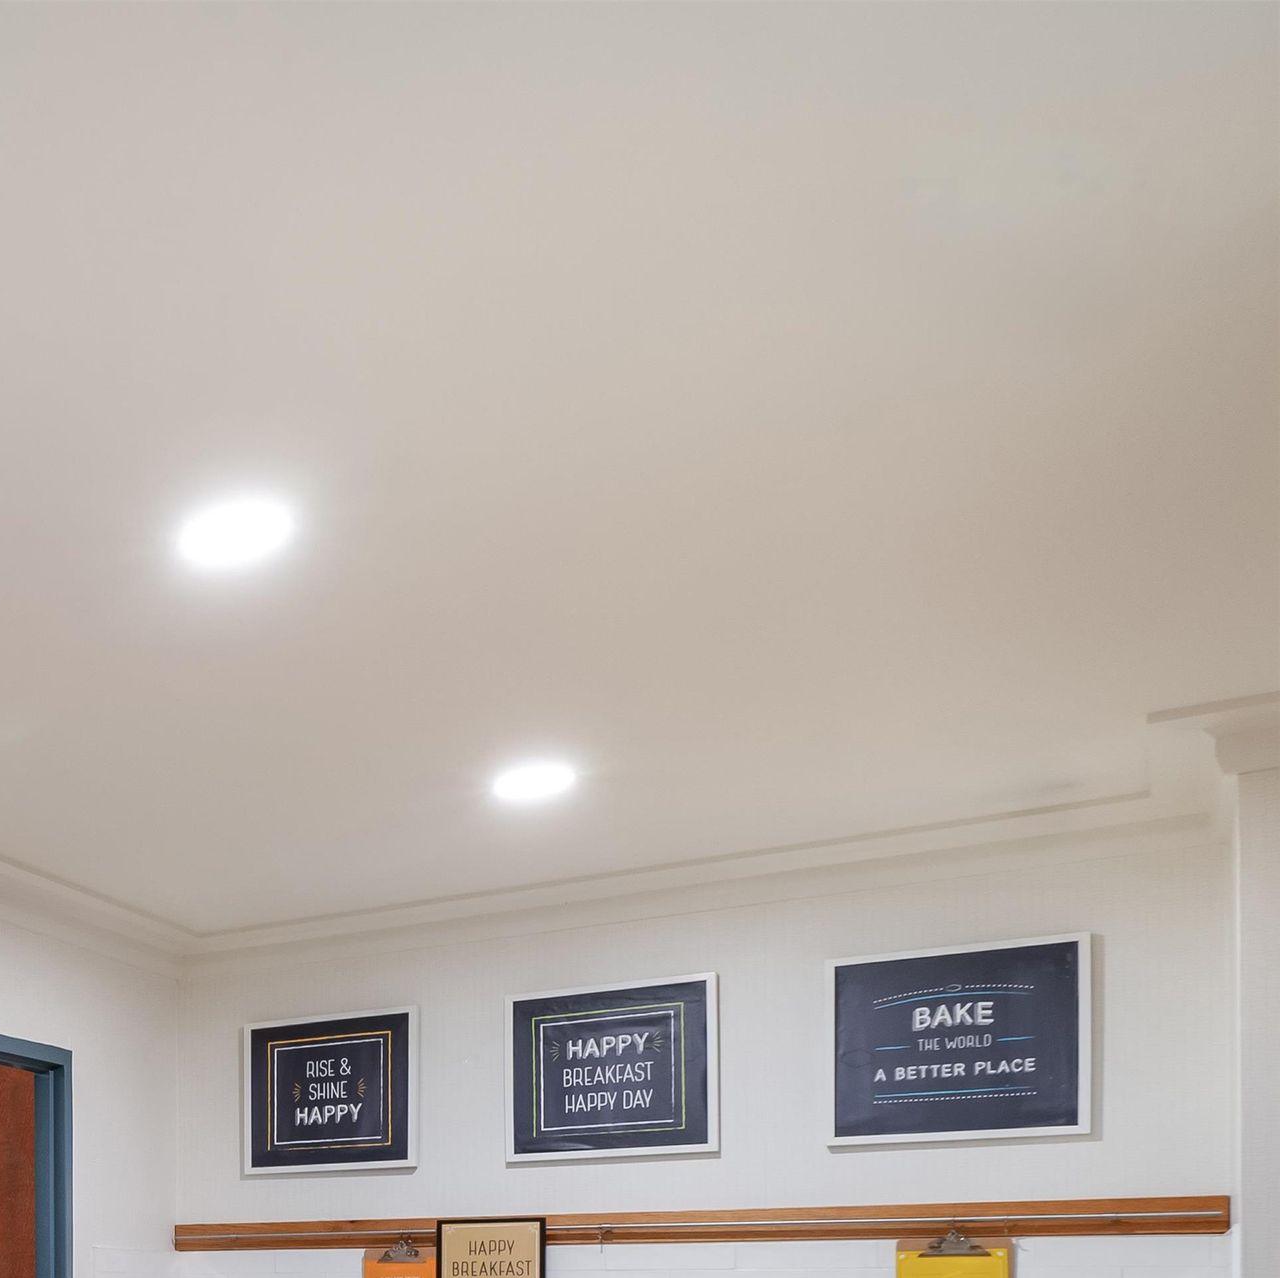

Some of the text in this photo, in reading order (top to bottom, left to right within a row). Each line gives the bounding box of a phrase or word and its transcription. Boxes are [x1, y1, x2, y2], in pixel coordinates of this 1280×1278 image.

[912, 1001, 995, 1032] BAKE
[566, 1032, 649, 1060] HAPPY
[917, 1034, 992, 1051] THE WORLD
[306, 1057, 351, 1078] RISE &
[563, 1061, 654, 1088] BREAKFAST
[873, 1057, 1037, 1082] A BETTER PLACE
[308, 1080, 348, 1101] SHINE
[565, 1088, 653, 1114] HAPPY DAY
[295, 1103, 363, 1126] HAPPY
[469, 1239, 515, 1256] HAPPY
[452, 1260, 532, 1277] BREAKFAST
